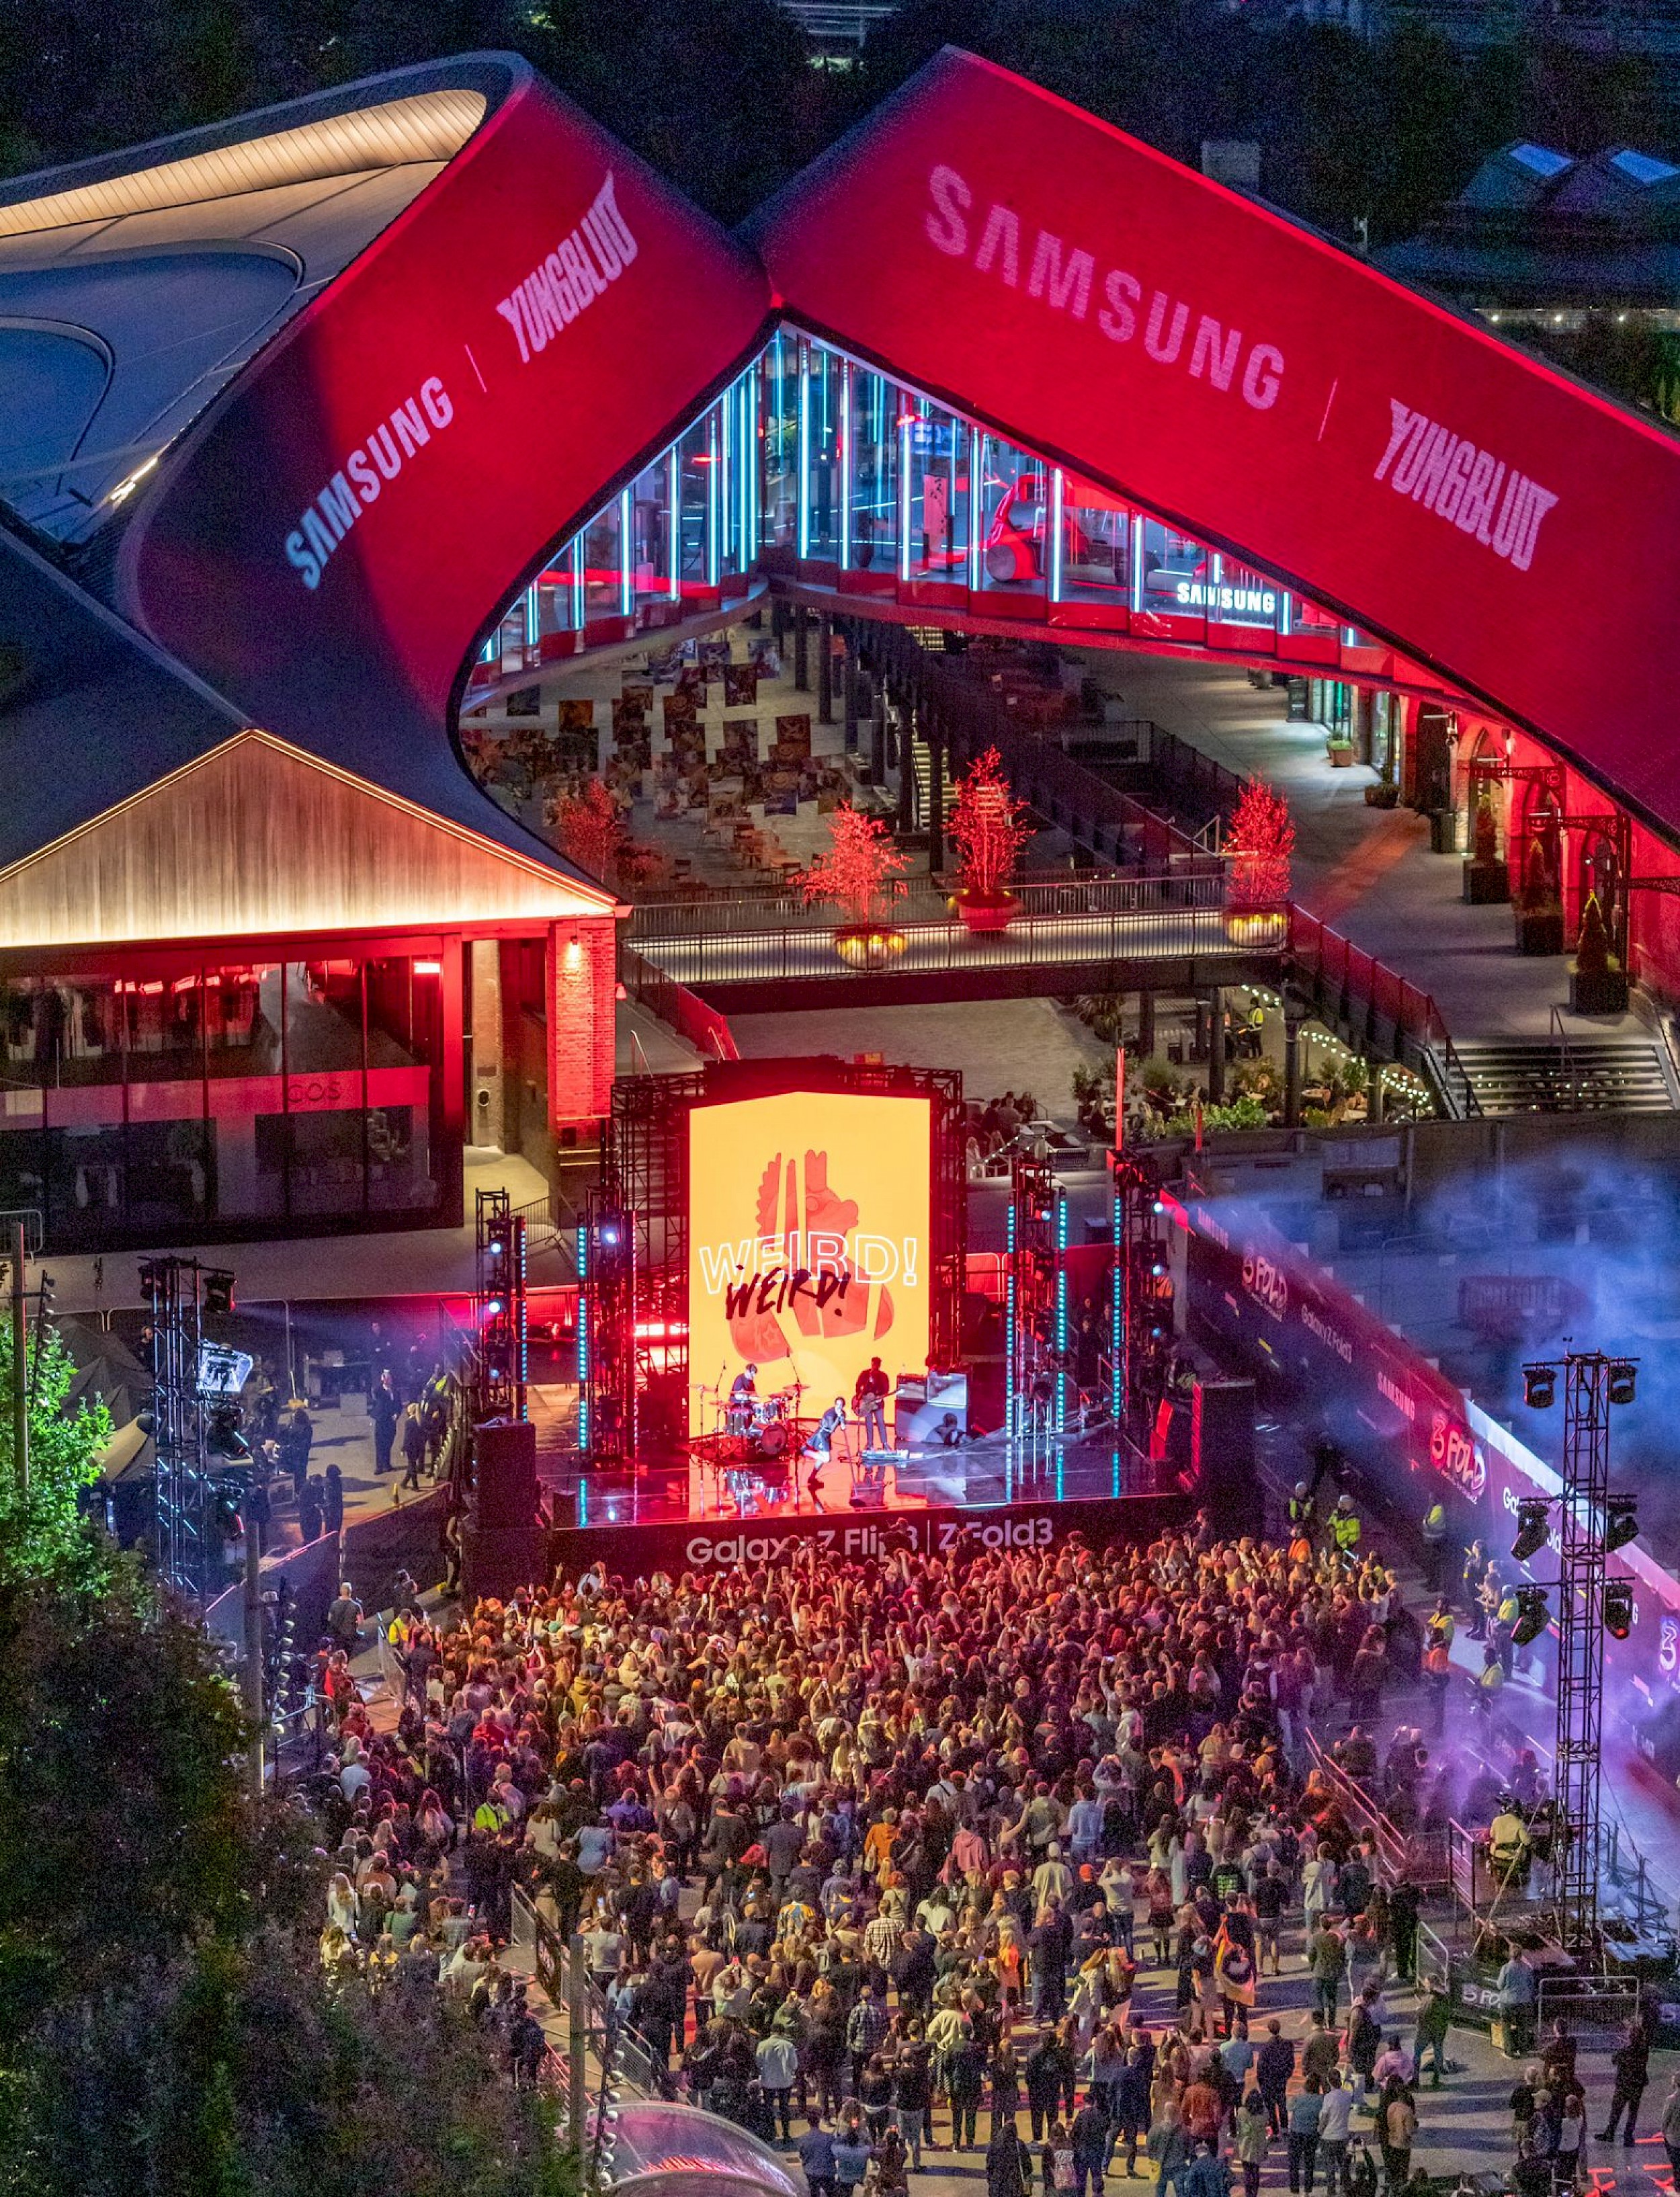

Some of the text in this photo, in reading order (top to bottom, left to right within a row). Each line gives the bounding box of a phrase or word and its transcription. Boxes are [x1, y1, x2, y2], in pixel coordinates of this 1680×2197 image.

[285, 169, 638, 590] SAMSUNG YUNGBLUD
[926, 165, 1559, 571] SAMSUNG YUNGBLUD
[1177, 582, 1275, 614] SAMSUNG
[288, 1081, 341, 1103] COS
[699, 1230, 918, 1295] WEIRD!
[726, 1265, 851, 1321] WEIRD!
[1378, 1371, 1415, 1421] SAMSUNG
[686, 1534, 790, 1564] Galax
[939, 1523, 957, 1550] Z
